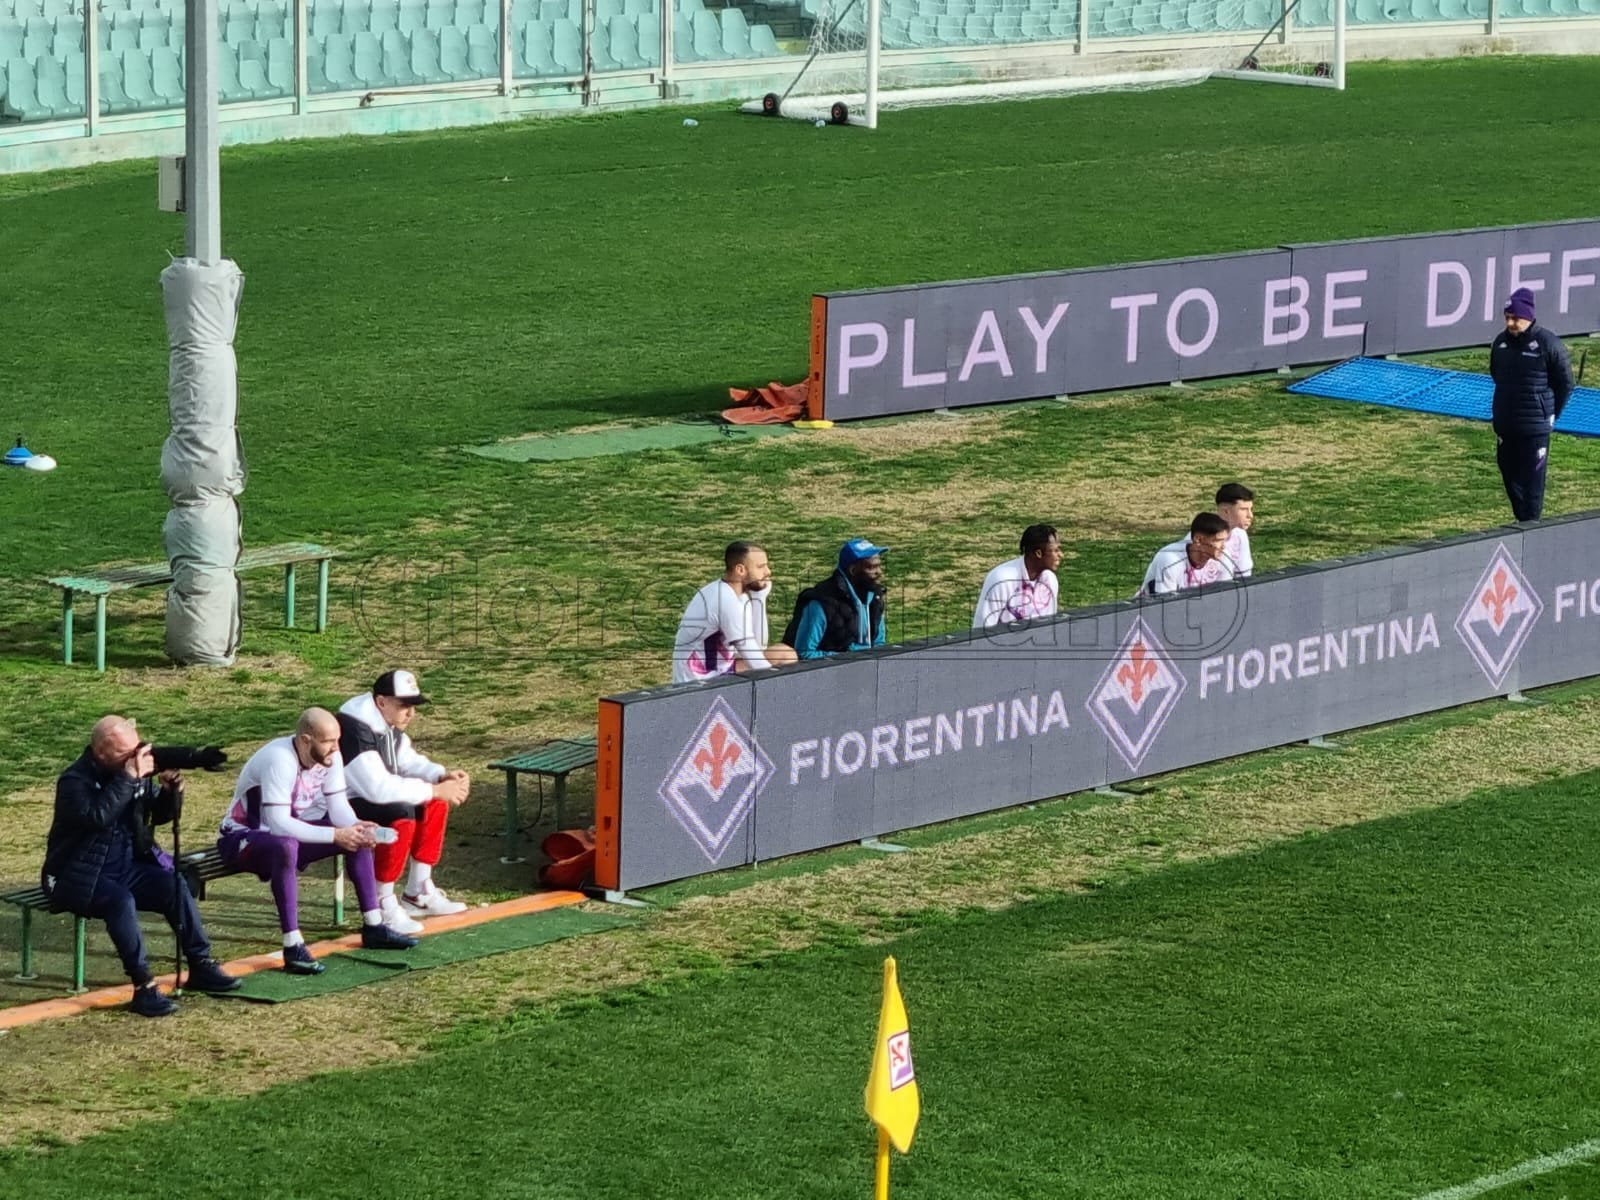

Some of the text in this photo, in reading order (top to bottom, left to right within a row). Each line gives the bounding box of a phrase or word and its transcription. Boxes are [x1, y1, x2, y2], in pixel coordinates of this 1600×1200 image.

[838, 302, 1070, 395] PLAY
[1110, 288, 1220, 363] TO
[1263, 270, 1368, 346] BE
[790, 691, 1070, 785] FIORENTINA
[1198, 613, 1441, 699] FIORENTINA
